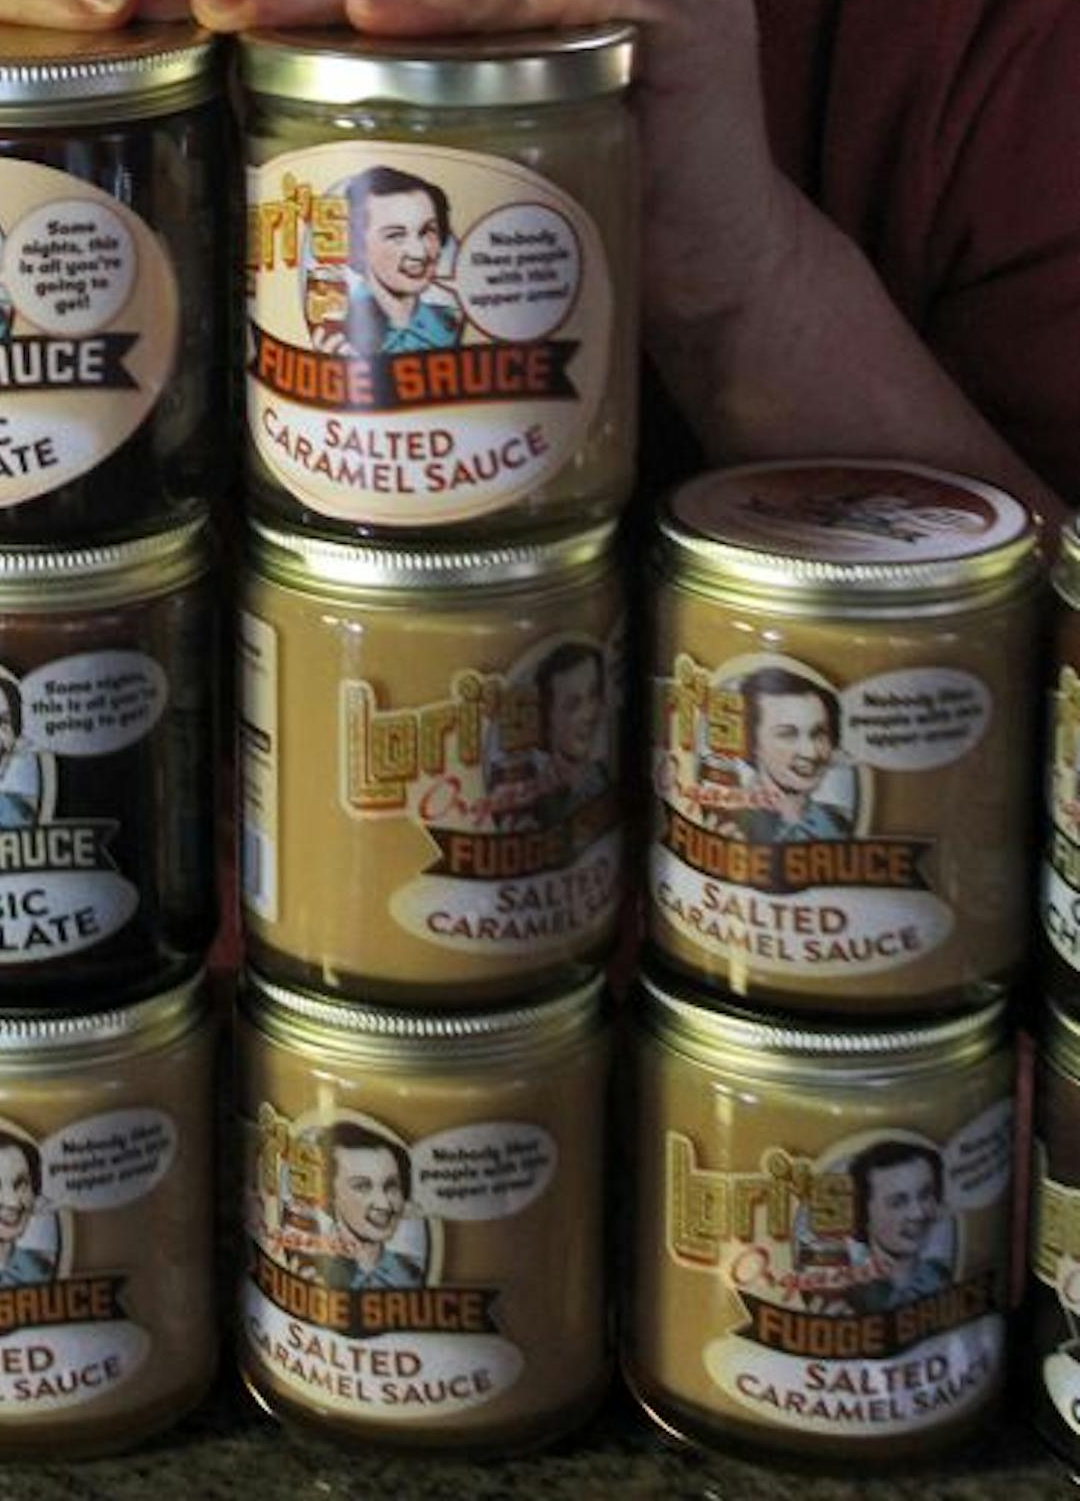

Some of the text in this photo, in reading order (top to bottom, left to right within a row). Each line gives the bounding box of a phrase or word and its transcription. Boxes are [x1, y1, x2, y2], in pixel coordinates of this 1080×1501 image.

[47, 221, 95, 235] Some
[36, 280, 86, 297] going
[38, 259, 61, 273] all
[259, 339, 551, 403] FUDGE SAUCE
[263, 407, 551, 494] CARAMEL SAUCE
[325, 419, 454, 460] SALTED
[671, 821, 772, 883] FUDGE
[783, 842, 915, 883] SAUCE
[426, 909, 582, 941] CARAMEL
[657, 883, 796, 960] CARAMEL
[805, 926, 920, 963] SAUCE
[701, 881, 848, 934] SALTED
[672, 1143, 855, 1266] Lori's
[261, 1266, 484, 1332] FUDGE SAUCE
[287, 1322, 422, 1377] SALTED
[758, 1306, 887, 1354] FUDGE
[13, 1355, 120, 1402] SAUCE
[249, 1316, 492, 1405] CARAMEL SAUCE
[804, 1354, 949, 1396] SALTED
[735, 1372, 908, 1422] CARAMEL
